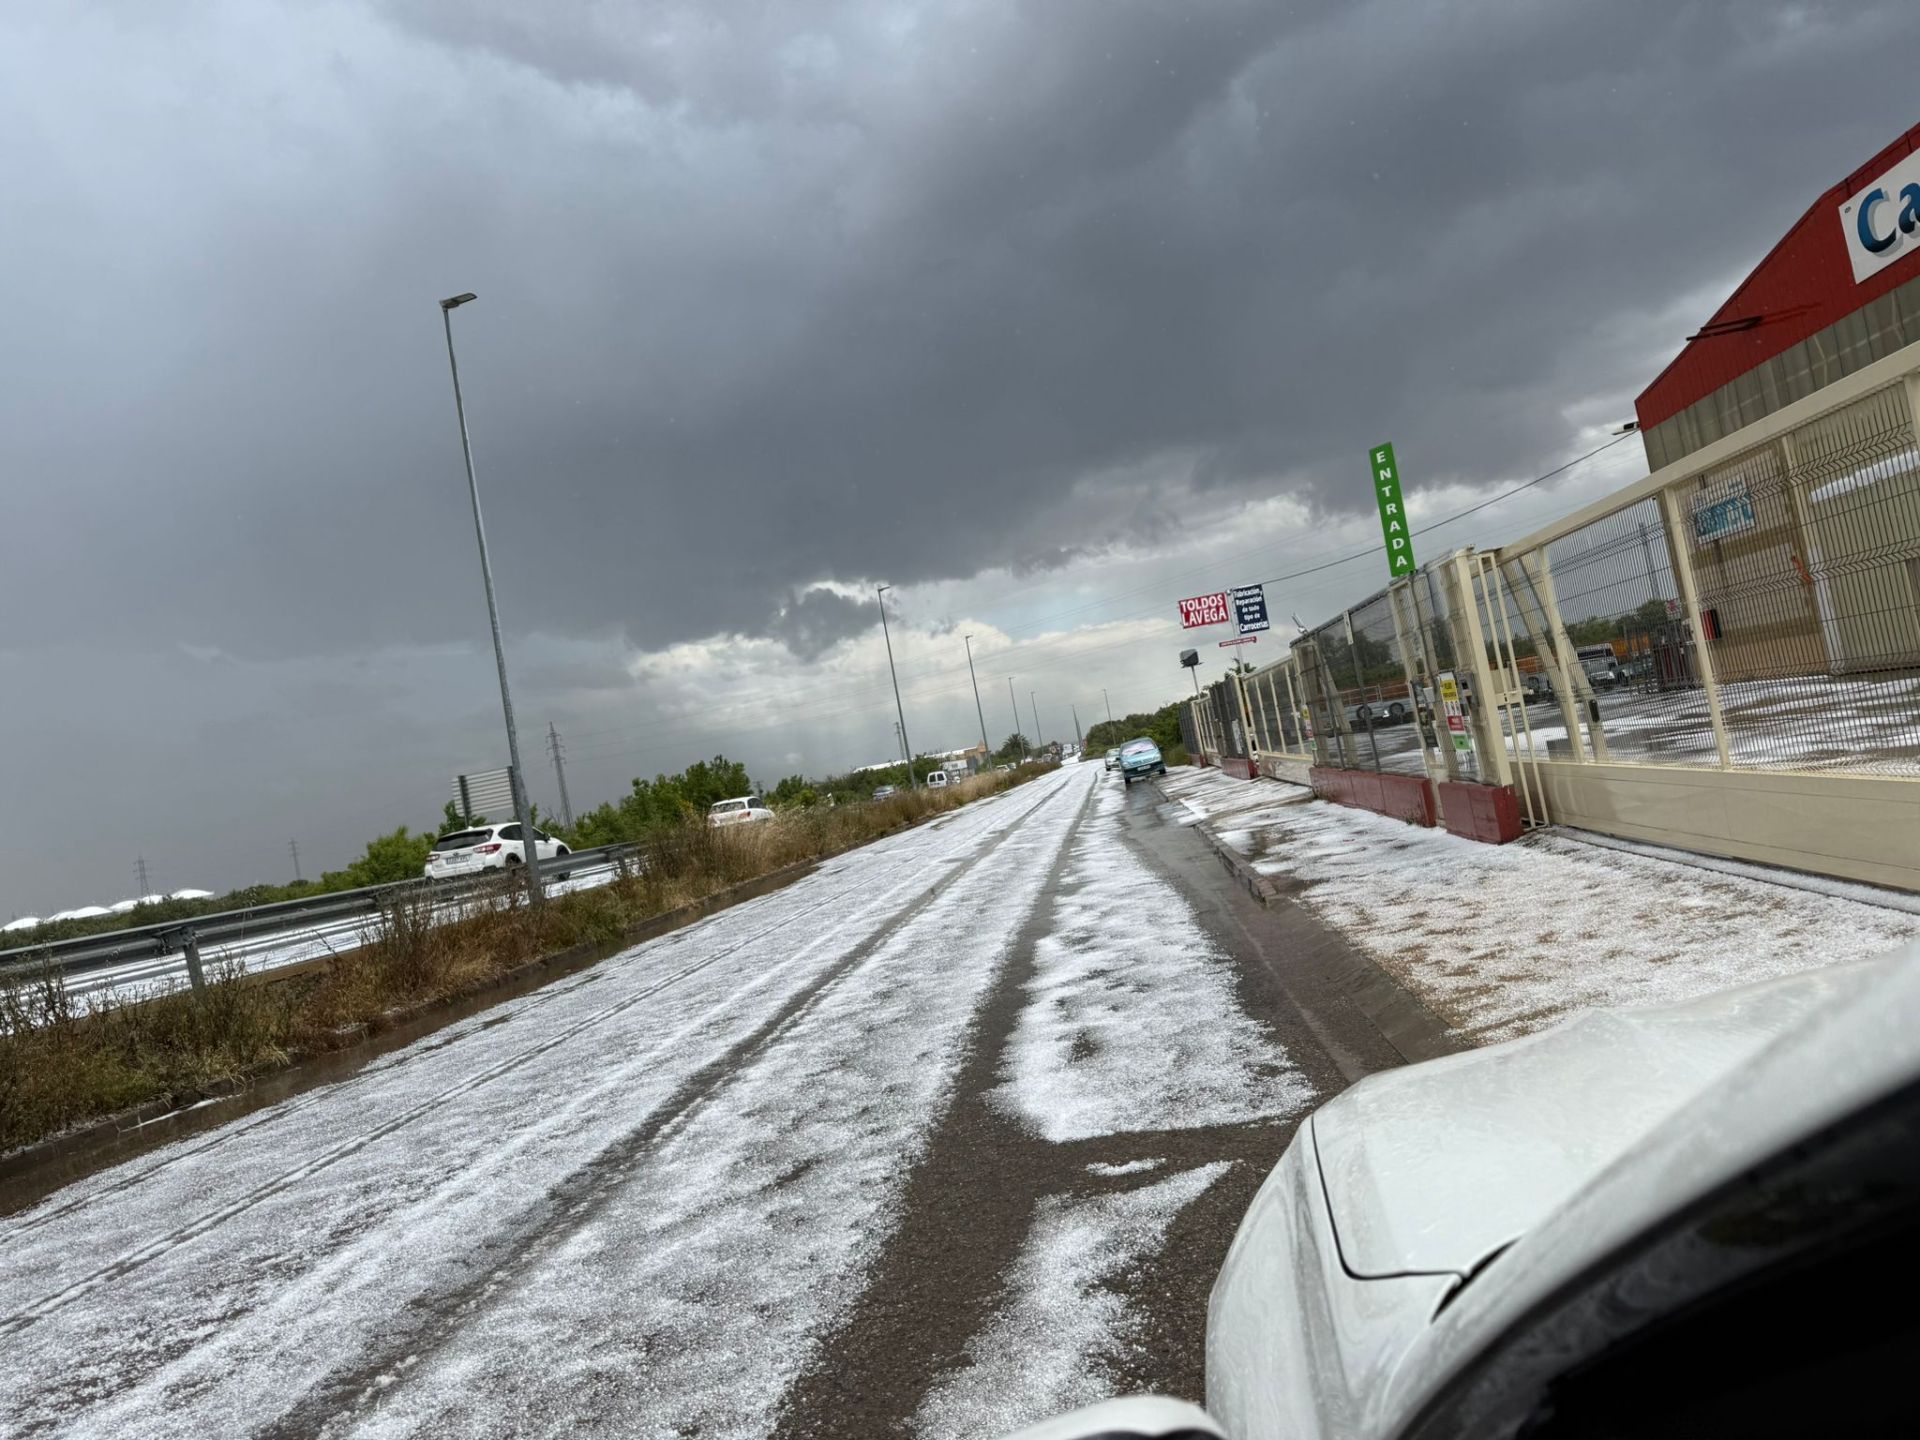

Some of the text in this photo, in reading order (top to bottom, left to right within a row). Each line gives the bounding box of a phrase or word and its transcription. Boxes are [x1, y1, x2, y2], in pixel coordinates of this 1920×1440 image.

[1376, 450, 1407, 567] ENTRADA
[1180, 594, 1223, 613] TOLDOS
[1182, 606, 1228, 627] LAVEGA
